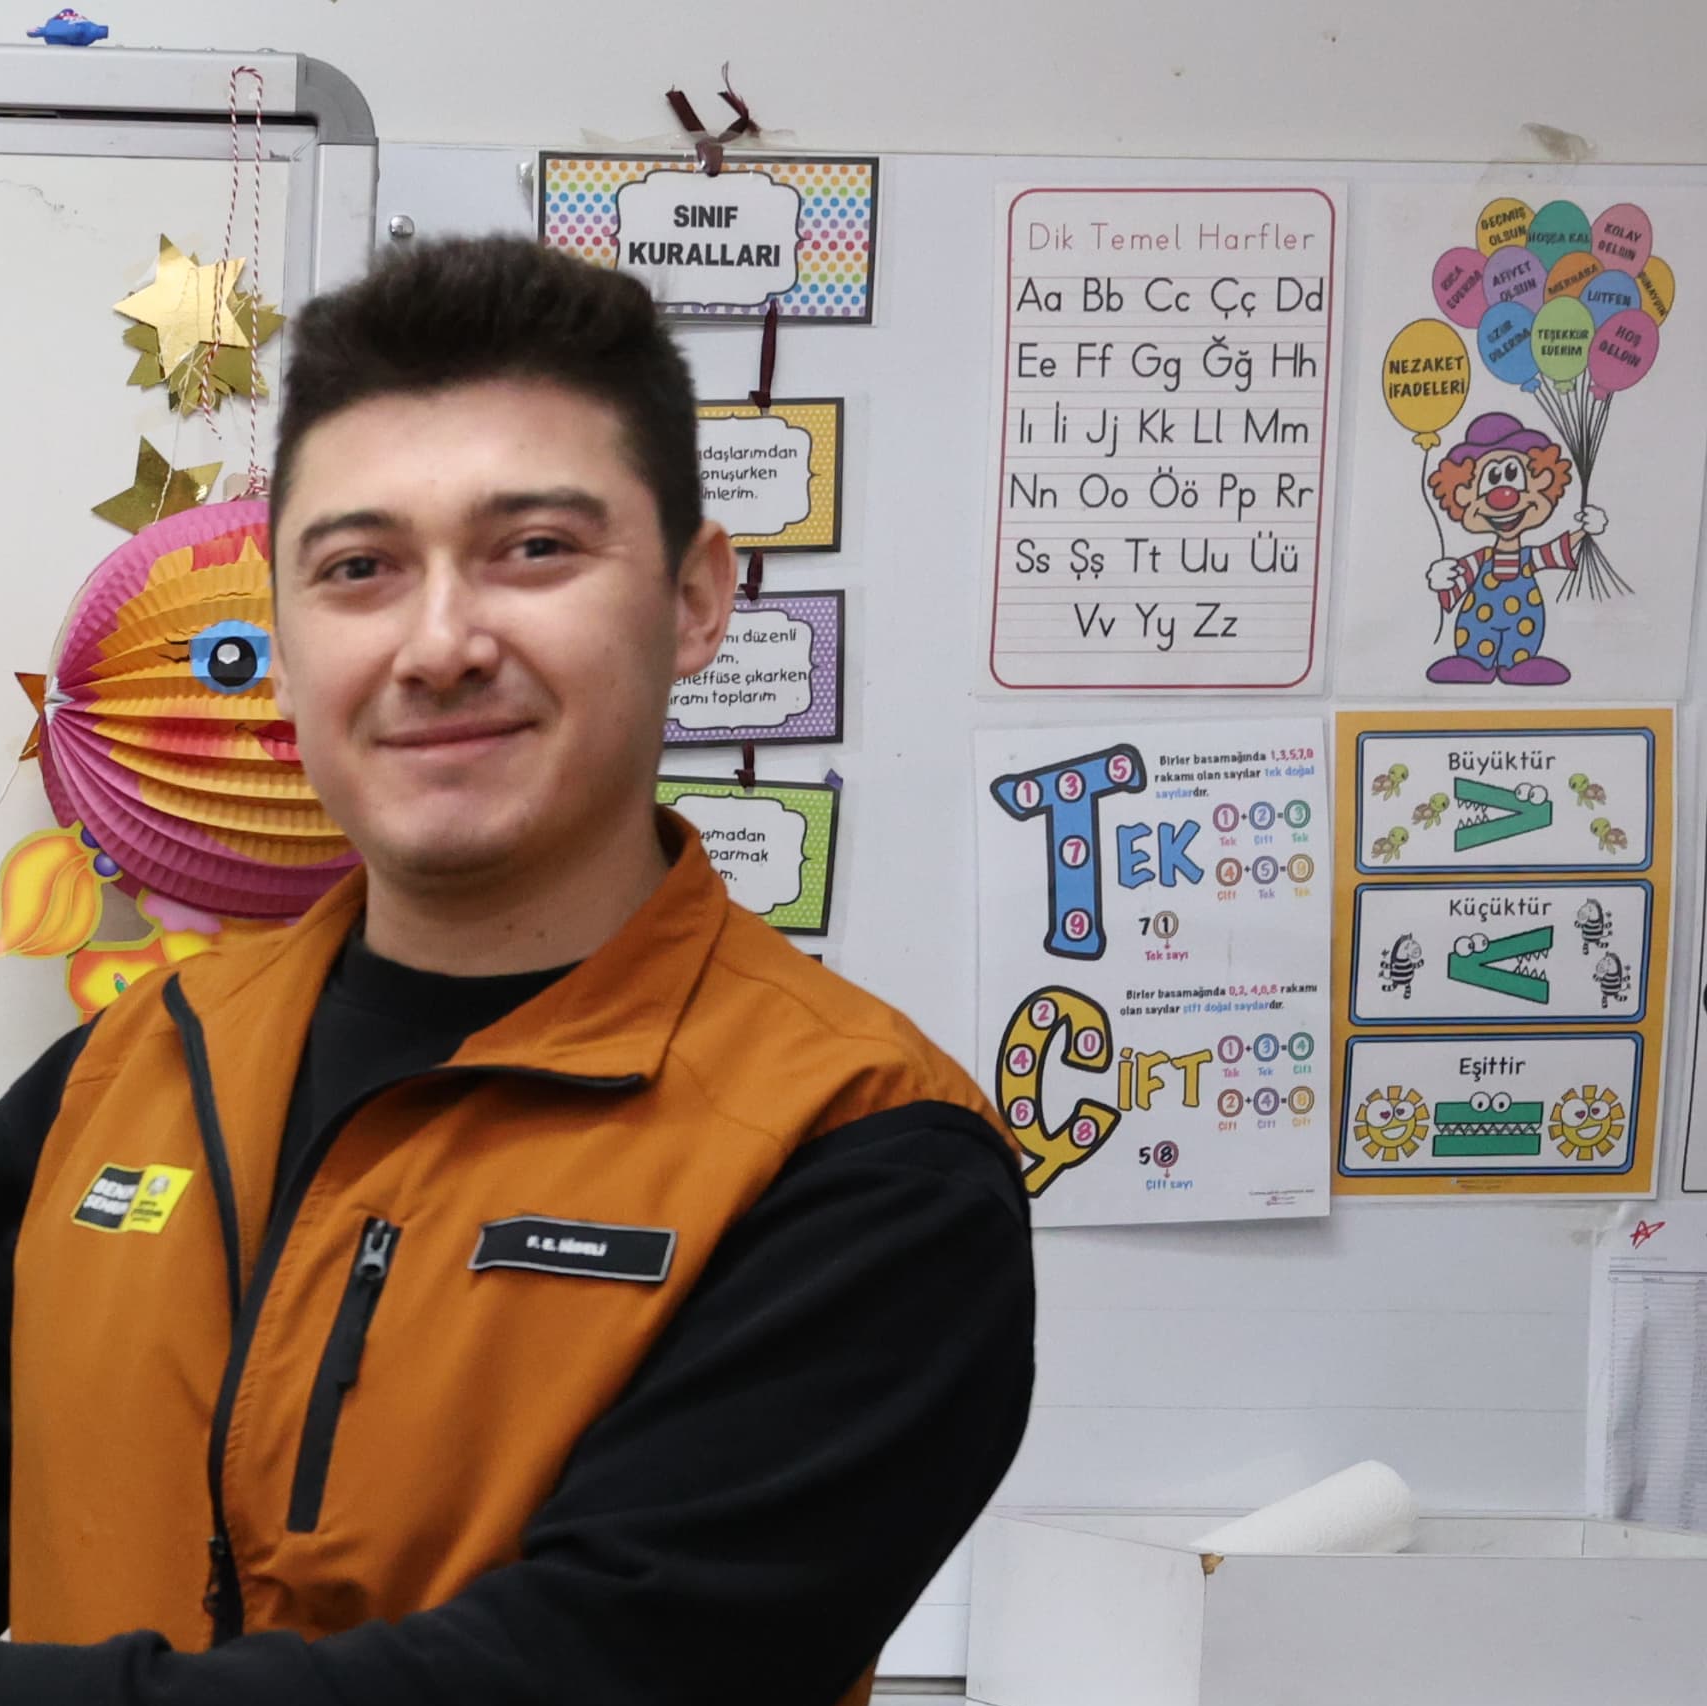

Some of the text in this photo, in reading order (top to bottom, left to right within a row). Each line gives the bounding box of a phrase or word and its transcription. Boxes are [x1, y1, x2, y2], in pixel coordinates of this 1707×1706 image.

[674, 205, 738, 227] SINIF
[1029, 222, 1316, 252] Dik Temel Harfler
[1604, 221, 1642, 244] KOLAY
[629, 243, 780, 267] KURALLARI
[1016, 277, 1323, 319] Aa Bb Cc Çç Dd
[1018, 335, 1316, 392] Ee Ff Gg Ğğ Hh
[1388, 355, 1464, 374] NEZAKET
[1388, 375, 1465, 398] İFADELERİ
[1086, 408, 1119, 457] Jj
[1139, 408, 1174, 444] Kk
[1194, 408, 1223, 444] Ll
[1244, 408, 1308, 444] Mm
[700, 466, 777, 482] onuşurken
[1009, 466, 1314, 523] Nn Oo Öö Pp Rr
[1016, 530, 1298, 580] Ss Şş Tt Uu Üü
[743, 629, 797, 643] düzenli
[1073, 603, 1238, 652] Vv Yy Zz
[673, 669, 808, 686] eneffüse çıkarken
[712, 691, 776, 705] toplarım
[1112, 759, 1127, 780] 5
[1160, 755, 1190, 766] Birler
[1194, 752, 1266, 764] basamağında
[1448, 751, 1556, 777] Büyüktür
[1155, 771, 1194, 782] rakamı
[1197, 771, 1221, 781] olan
[1224, 769, 1261, 781] sayılar
[1286, 766, 1314, 777] doğal
[1063, 775, 1078, 795] 3
[699, 829, 765, 843] uşmadan
[1067, 842, 1082, 864] 7
[1449, 897, 1552, 922] Küçüktür
[1069, 915, 1085, 936] 9
[1145, 950, 1164, 960] Tek
[1126, 990, 1155, 1000] Birler
[1158, 987, 1226, 999] basamağında
[1280, 985, 1318, 994] rakamı
[1036, 1004, 1050, 1023] 2
[1120, 1006, 1142, 1016] olan
[1145, 1004, 1179, 1015] sayılar
[1204, 1001, 1232, 1013] doğal
[1013, 1051, 1029, 1069] 4
[1458, 1056, 1527, 1078] Eşittir
[1014, 1103, 1029, 1121] 6
